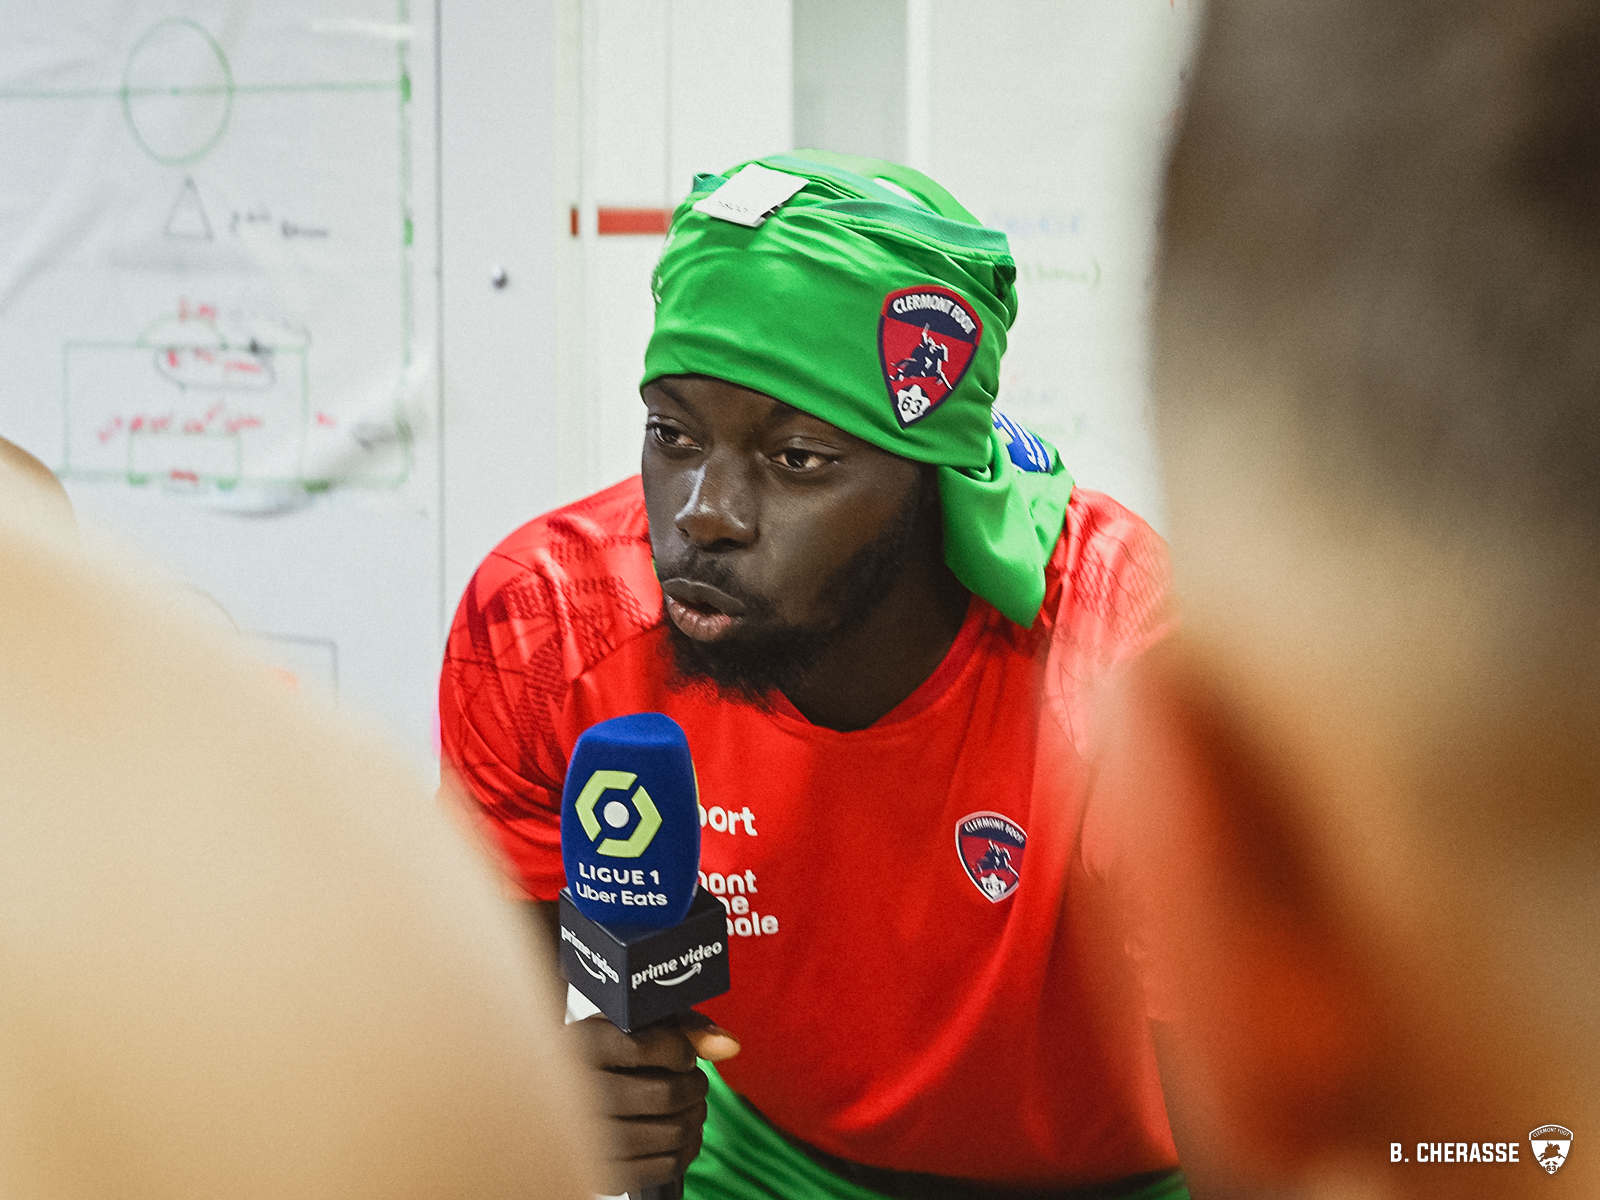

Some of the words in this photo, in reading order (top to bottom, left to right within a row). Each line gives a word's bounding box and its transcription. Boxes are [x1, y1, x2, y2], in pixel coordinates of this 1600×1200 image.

[892, 293, 954, 315] CLERMONT
[949, 304, 977, 335] FOOT
[901, 396, 923, 415] 63
[578, 862, 645, 886] LIGUE
[649, 869, 660, 885] 1
[575, 881, 618, 905] Uber
[620, 889, 668, 906] Eats
[631, 958, 679, 990] prime
[679, 941, 723, 967] video
